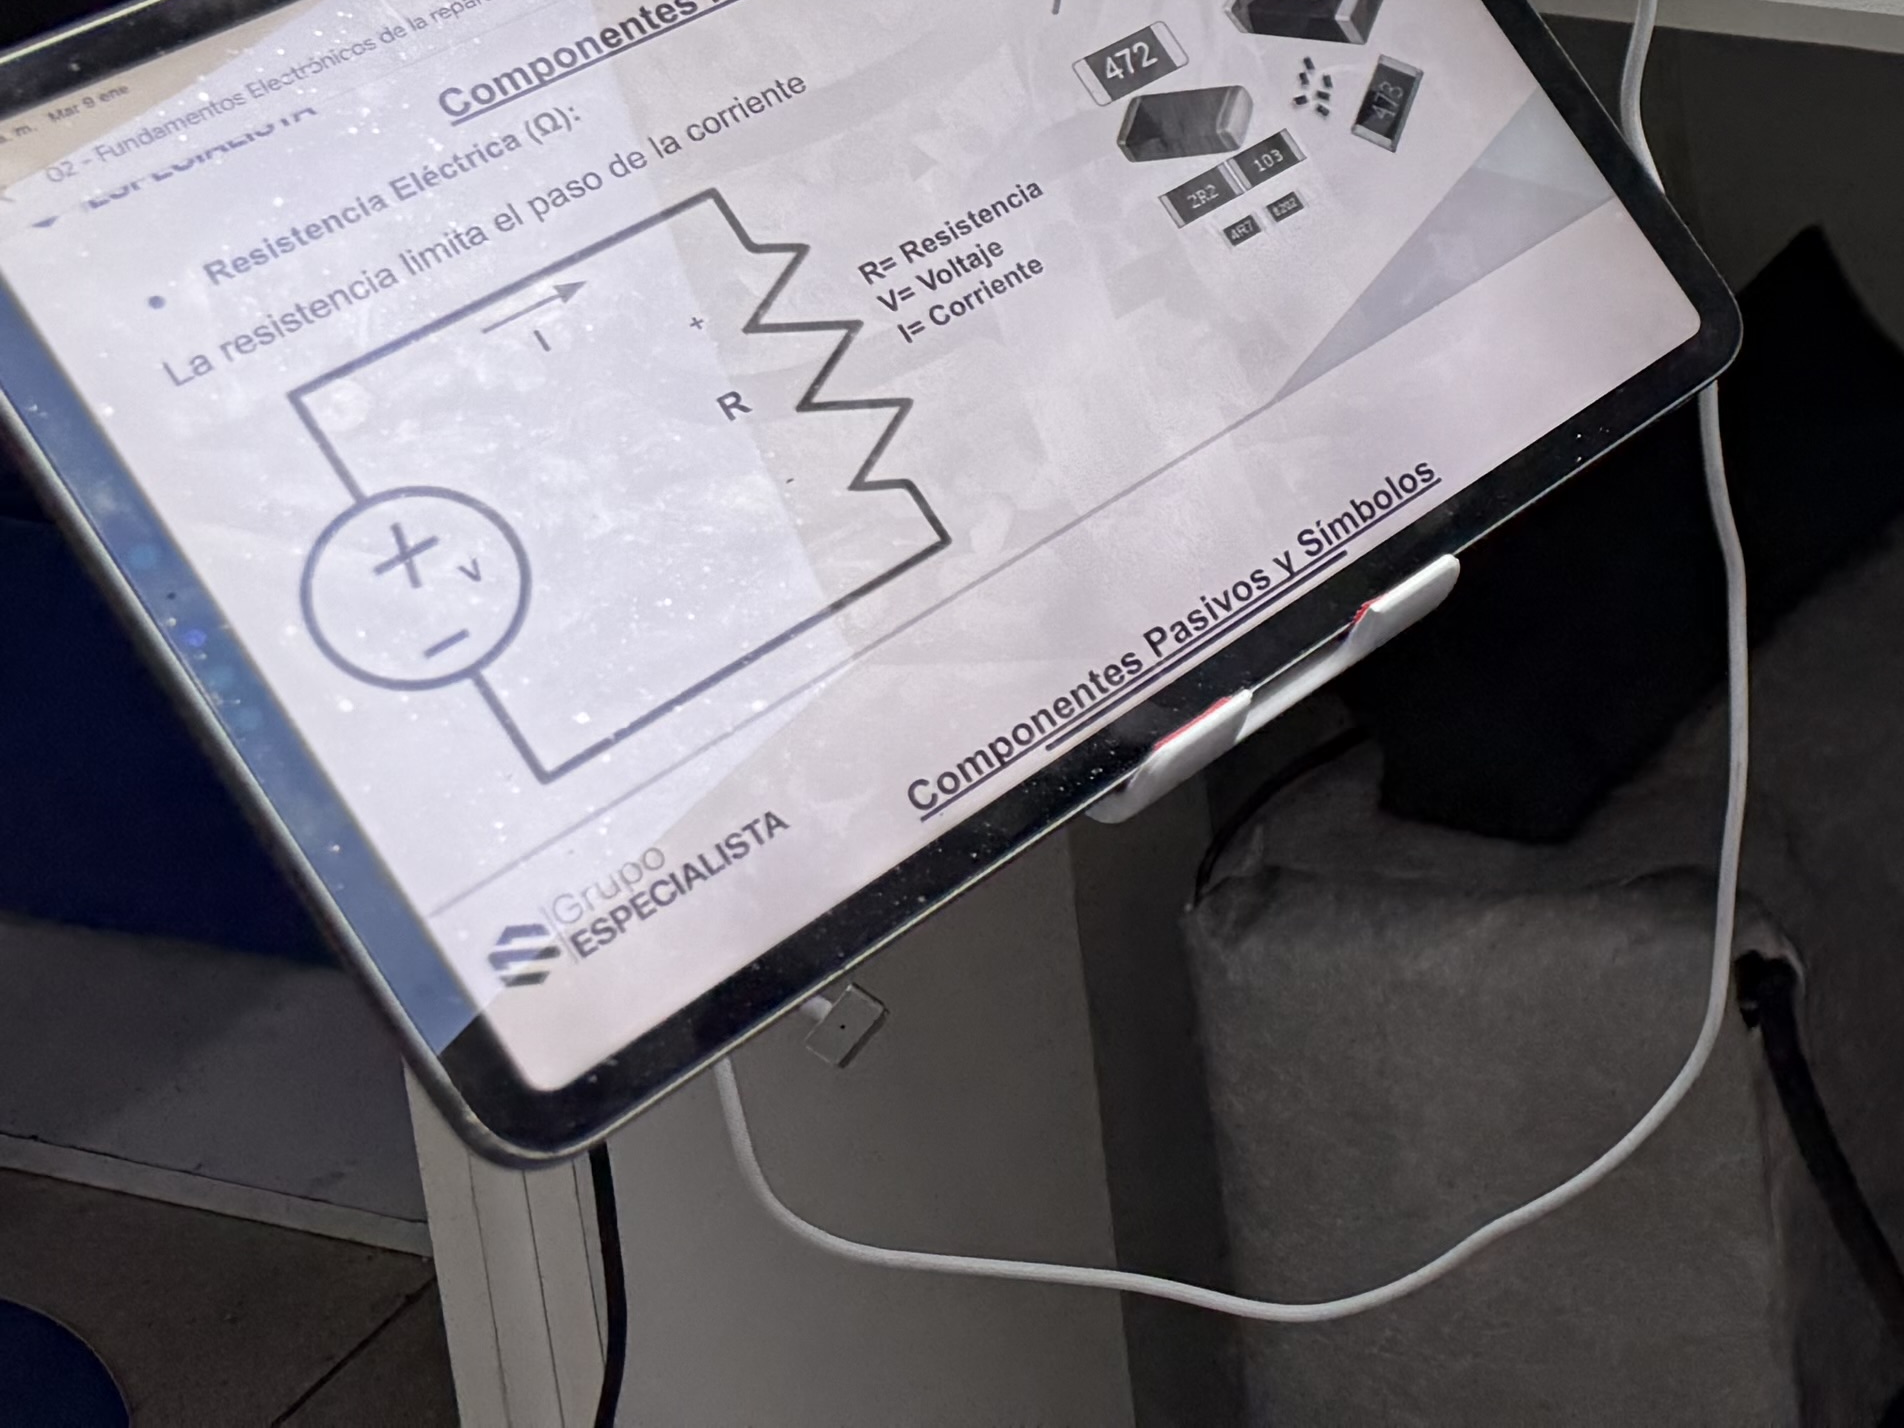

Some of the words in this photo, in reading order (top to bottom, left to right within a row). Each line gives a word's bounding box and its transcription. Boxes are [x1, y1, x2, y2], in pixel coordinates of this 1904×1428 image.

[83, 95, 94, 109] 9
[100, 84, 129, 103] ene
[97, 90, 246, 164] Fundamentos
[246, 37, 377, 101] Electrónicos
[378, 23, 406, 46] de
[409, 10, 429, 35] la
[1104, 41, 1158, 82] 472
[1370, 80, 1405, 122] 473
[1186, 183, 1219, 210] 2R2
[1252, 147, 1284, 174] 103
[163, 350, 214, 389] La
[219, 270, 399, 361] resistencia
[400, 221, 488, 278] limita
[493, 201, 522, 233] el
[527, 170, 603, 225] paso
[607, 147, 648, 179] de
[648, 130, 681, 158] la
[686, 70, 807, 144] corriente
[204, 192, 389, 286] Resistencia
[389, 131, 521, 204] Eléctrica
[858, 254, 897, 286] R=
[900, 179, 1043, 261] Resistencia
[1229, 219, 1254, 243] 4R7
[878, 283, 916, 314] V=
[917, 238, 1005, 293] Voltaje
[929, 256, 1045, 329] Corriente
[718, 388, 753, 423] R
[907, 651, 1143, 812] Componentes
[1143, 568, 1271, 658] Pasivos
[1273, 553, 1295, 579] y
[1296, 460, 1436, 559] Símbolos
[553, 846, 665, 925] Grupo
[570, 810, 790, 959] ESPECIALISTA
